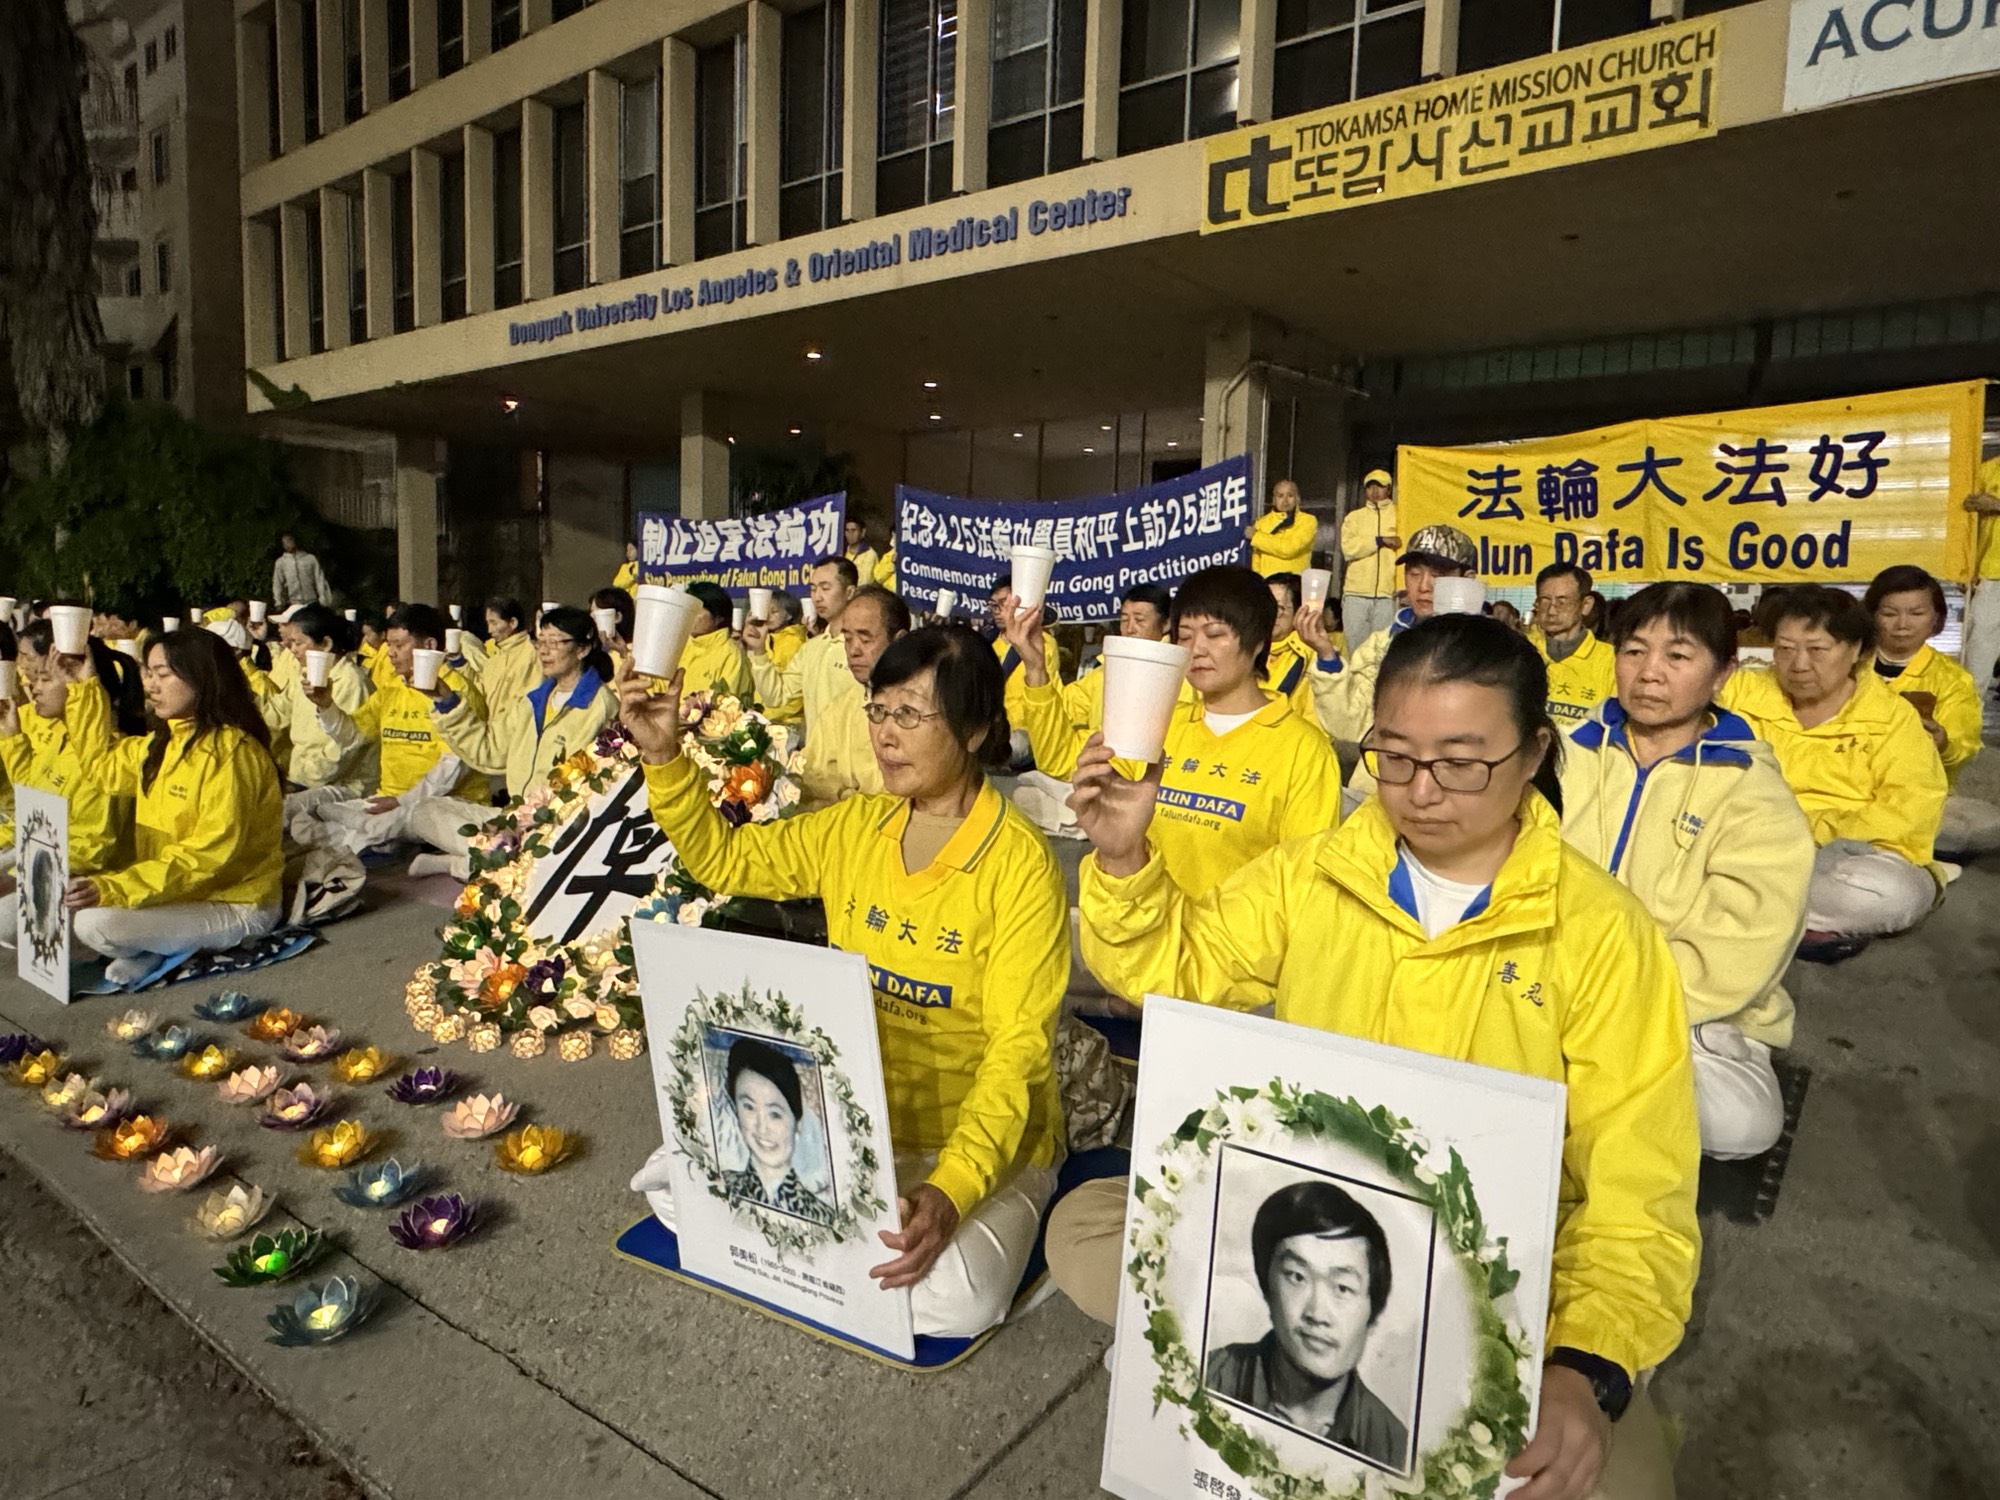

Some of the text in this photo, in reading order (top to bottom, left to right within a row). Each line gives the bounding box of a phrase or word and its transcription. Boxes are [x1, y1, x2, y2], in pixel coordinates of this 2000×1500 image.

[1296, 28, 1717, 153] TTOKAMSA HOME MISSION CHURCH
[509, 186, 1132, 346] Dongguk University Los Angeles & Oriental Medical Center
[1458, 430, 1890, 524] 法輪大法好
[642, 500, 840, 566] 制止迫害法輪功
[1472, 519, 1851, 576] alun Dafa Is Good
[719, 569, 730, 588] of
[730, 567, 757, 588] Falun
[759, 564, 787, 590] Gong
[788, 564, 799, 585] in
[1069, 574, 1114, 594] Gong
[1086, 602, 1108, 617] on
[1554, 704, 1584, 718] DAFA
[1160, 807, 1222, 831] falundafa.org
[1194, 796, 1238, 818] DAFA
[886, 975, 945, 1005] DAFA
